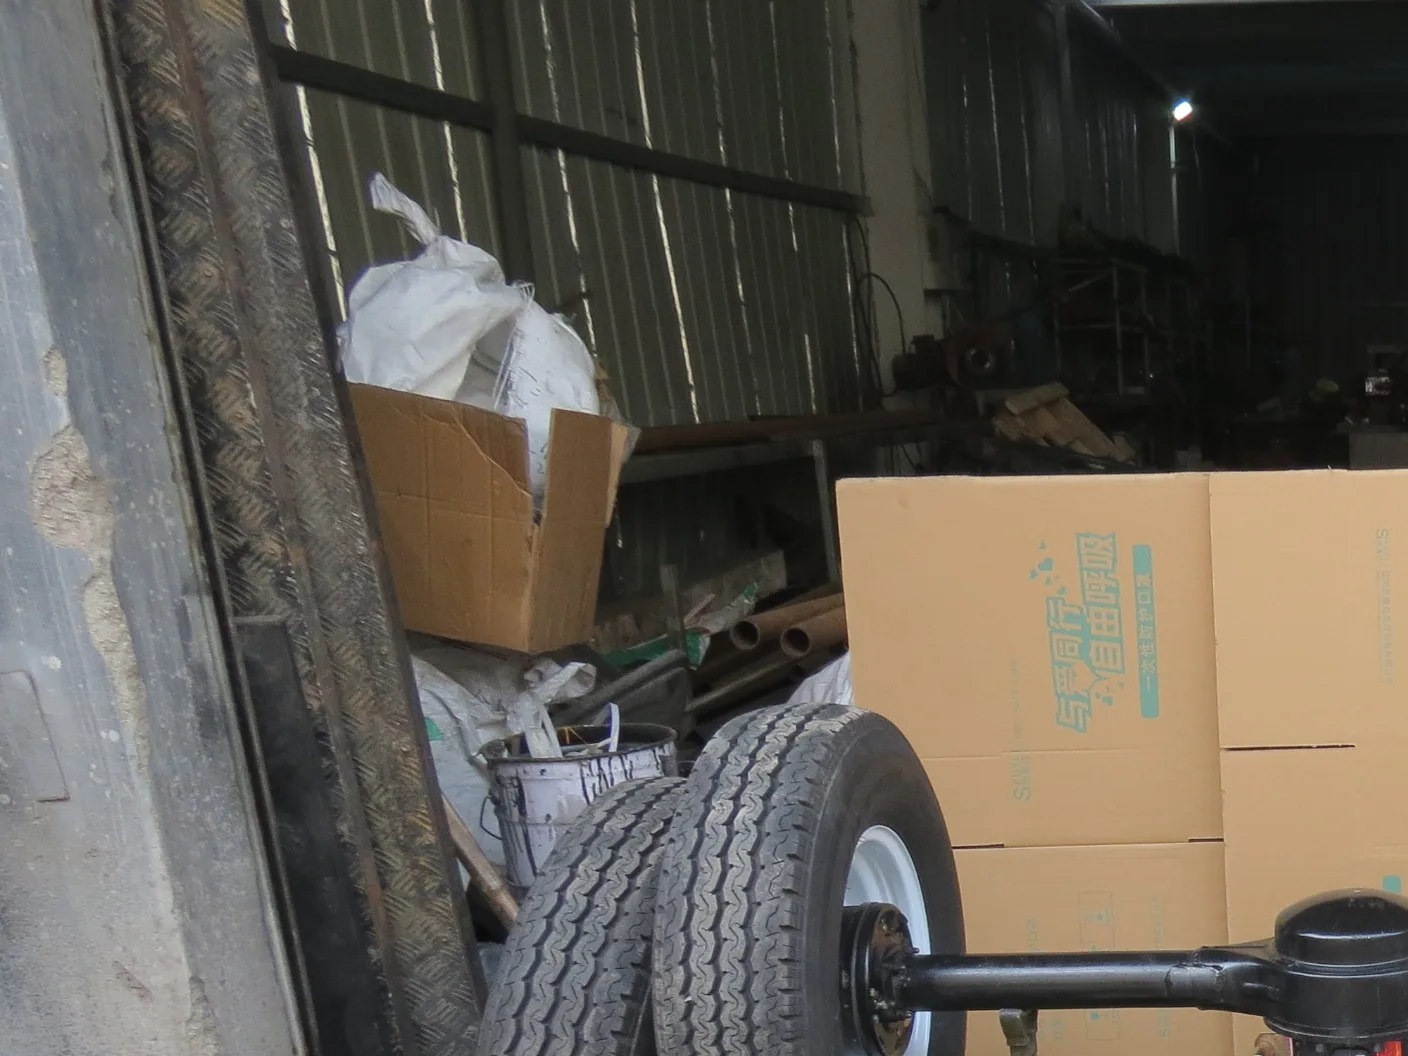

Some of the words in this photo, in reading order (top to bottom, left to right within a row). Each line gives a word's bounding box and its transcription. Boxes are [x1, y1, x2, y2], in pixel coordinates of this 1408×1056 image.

[1046, 598, 1093, 732] 与爱同行
[1077, 532, 1124, 674] 自由呼吸
